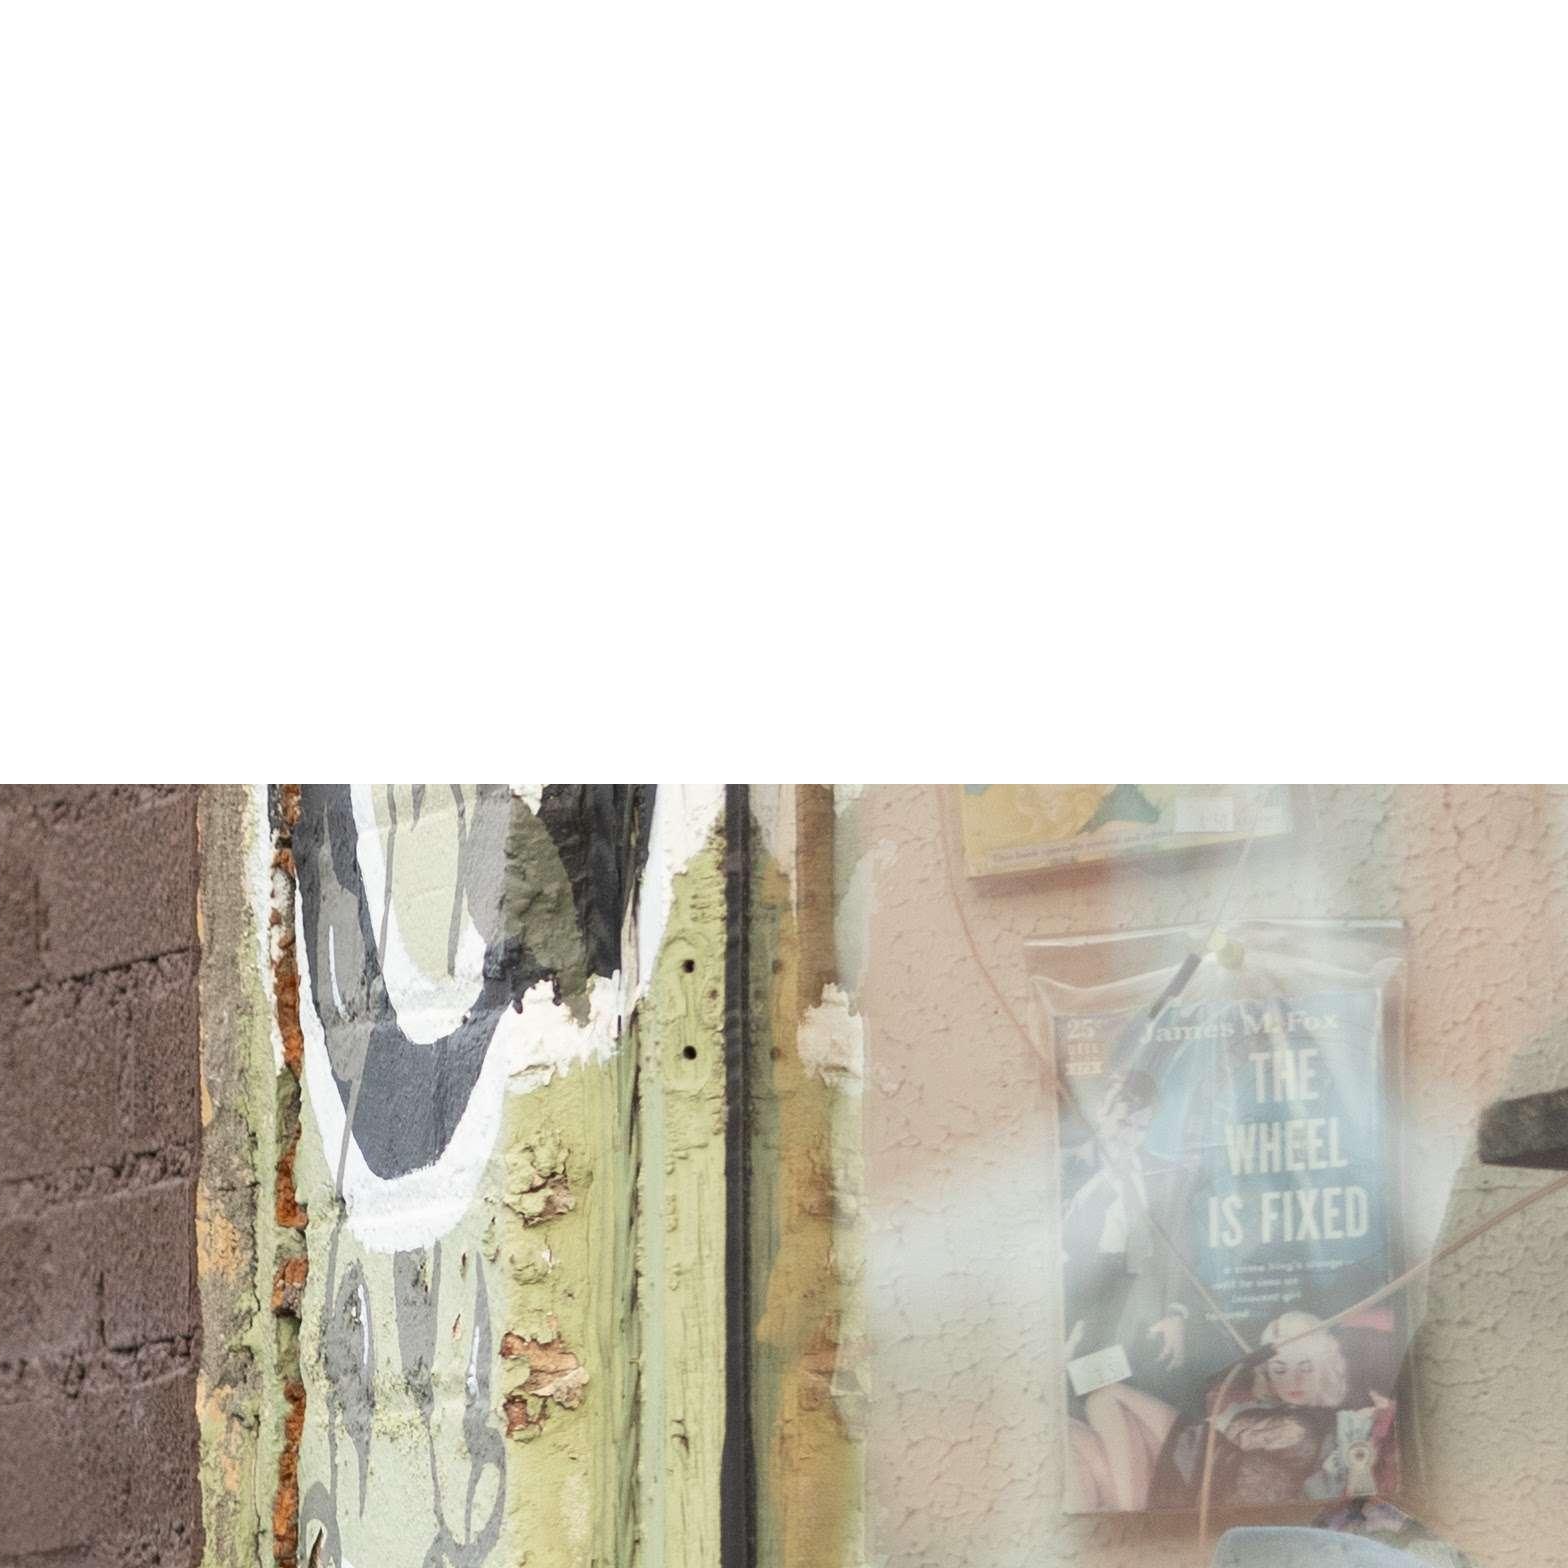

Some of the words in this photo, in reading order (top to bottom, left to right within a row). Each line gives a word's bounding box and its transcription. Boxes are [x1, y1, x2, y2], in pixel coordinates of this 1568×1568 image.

[1141, 1019, 1235, 1043] James
[1287, 1010, 1339, 1031] Fox
[1248, 1049, 1320, 1104] THE
[1225, 1117, 1348, 1176] WHEEL
[1208, 1195, 1245, 1249] IS
[1261, 1185, 1370, 1245] FIXED
